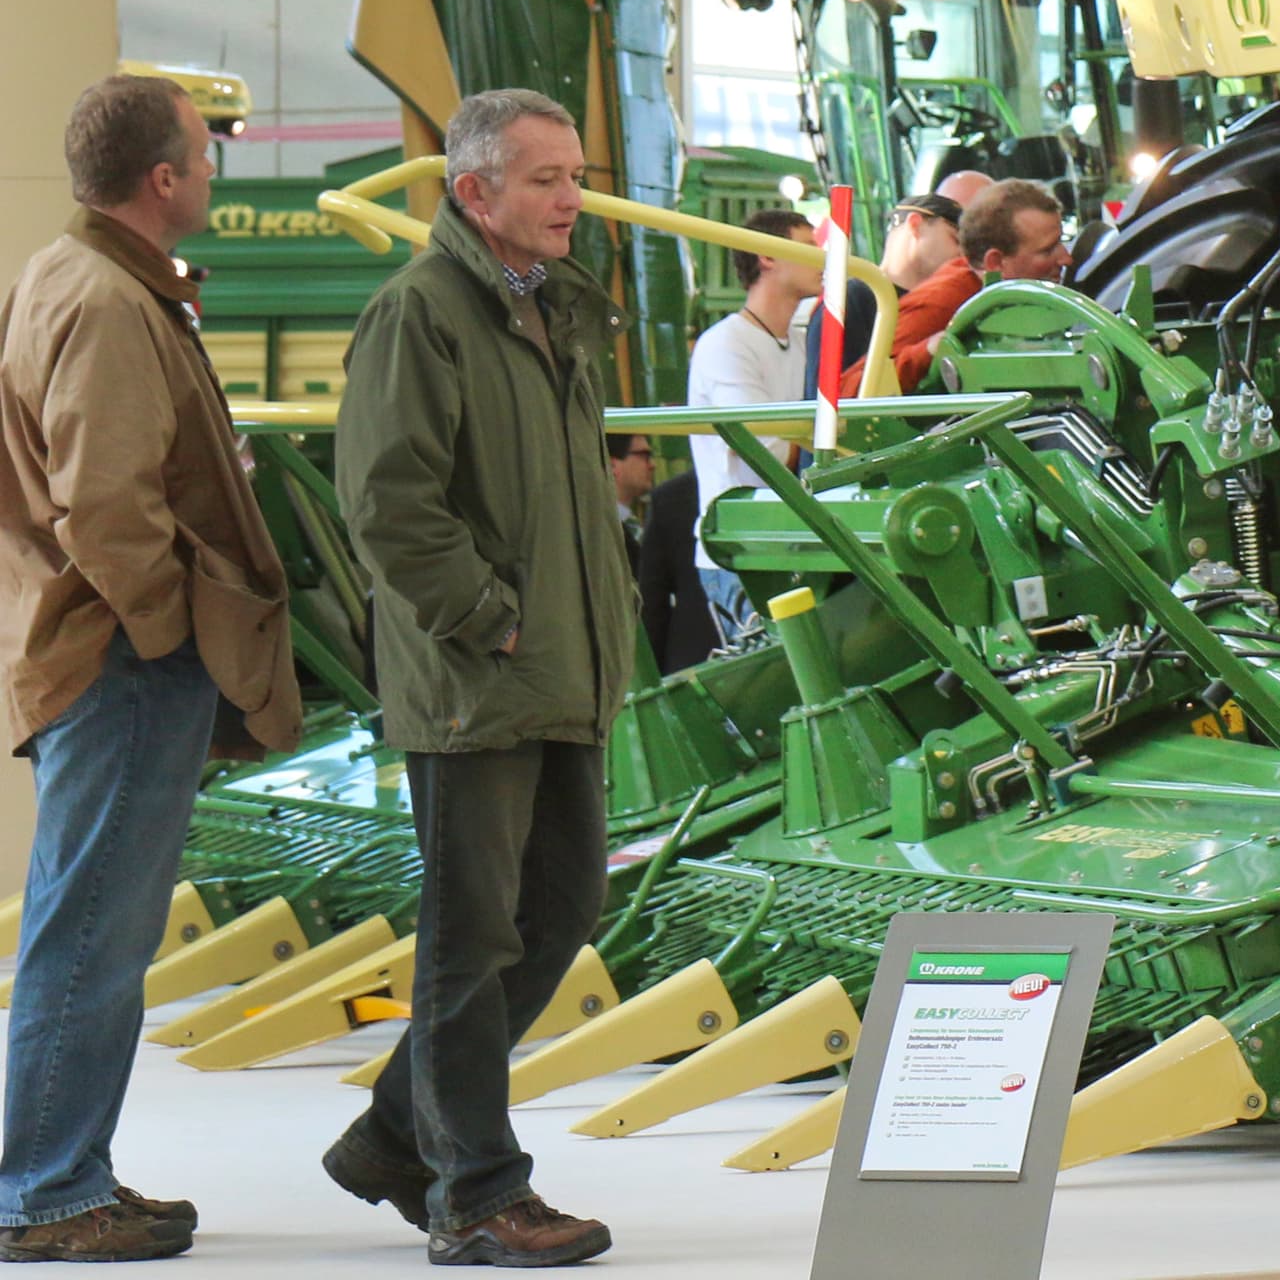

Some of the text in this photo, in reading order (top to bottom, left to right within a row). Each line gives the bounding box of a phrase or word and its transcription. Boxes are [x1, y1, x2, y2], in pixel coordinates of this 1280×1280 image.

[258, 210, 342, 237] KRO
[934, 966, 985, 976] KRONE
[1014, 979, 1043, 994] NEU!
[914, 1007, 1031, 1021] EASYCOLLECT
